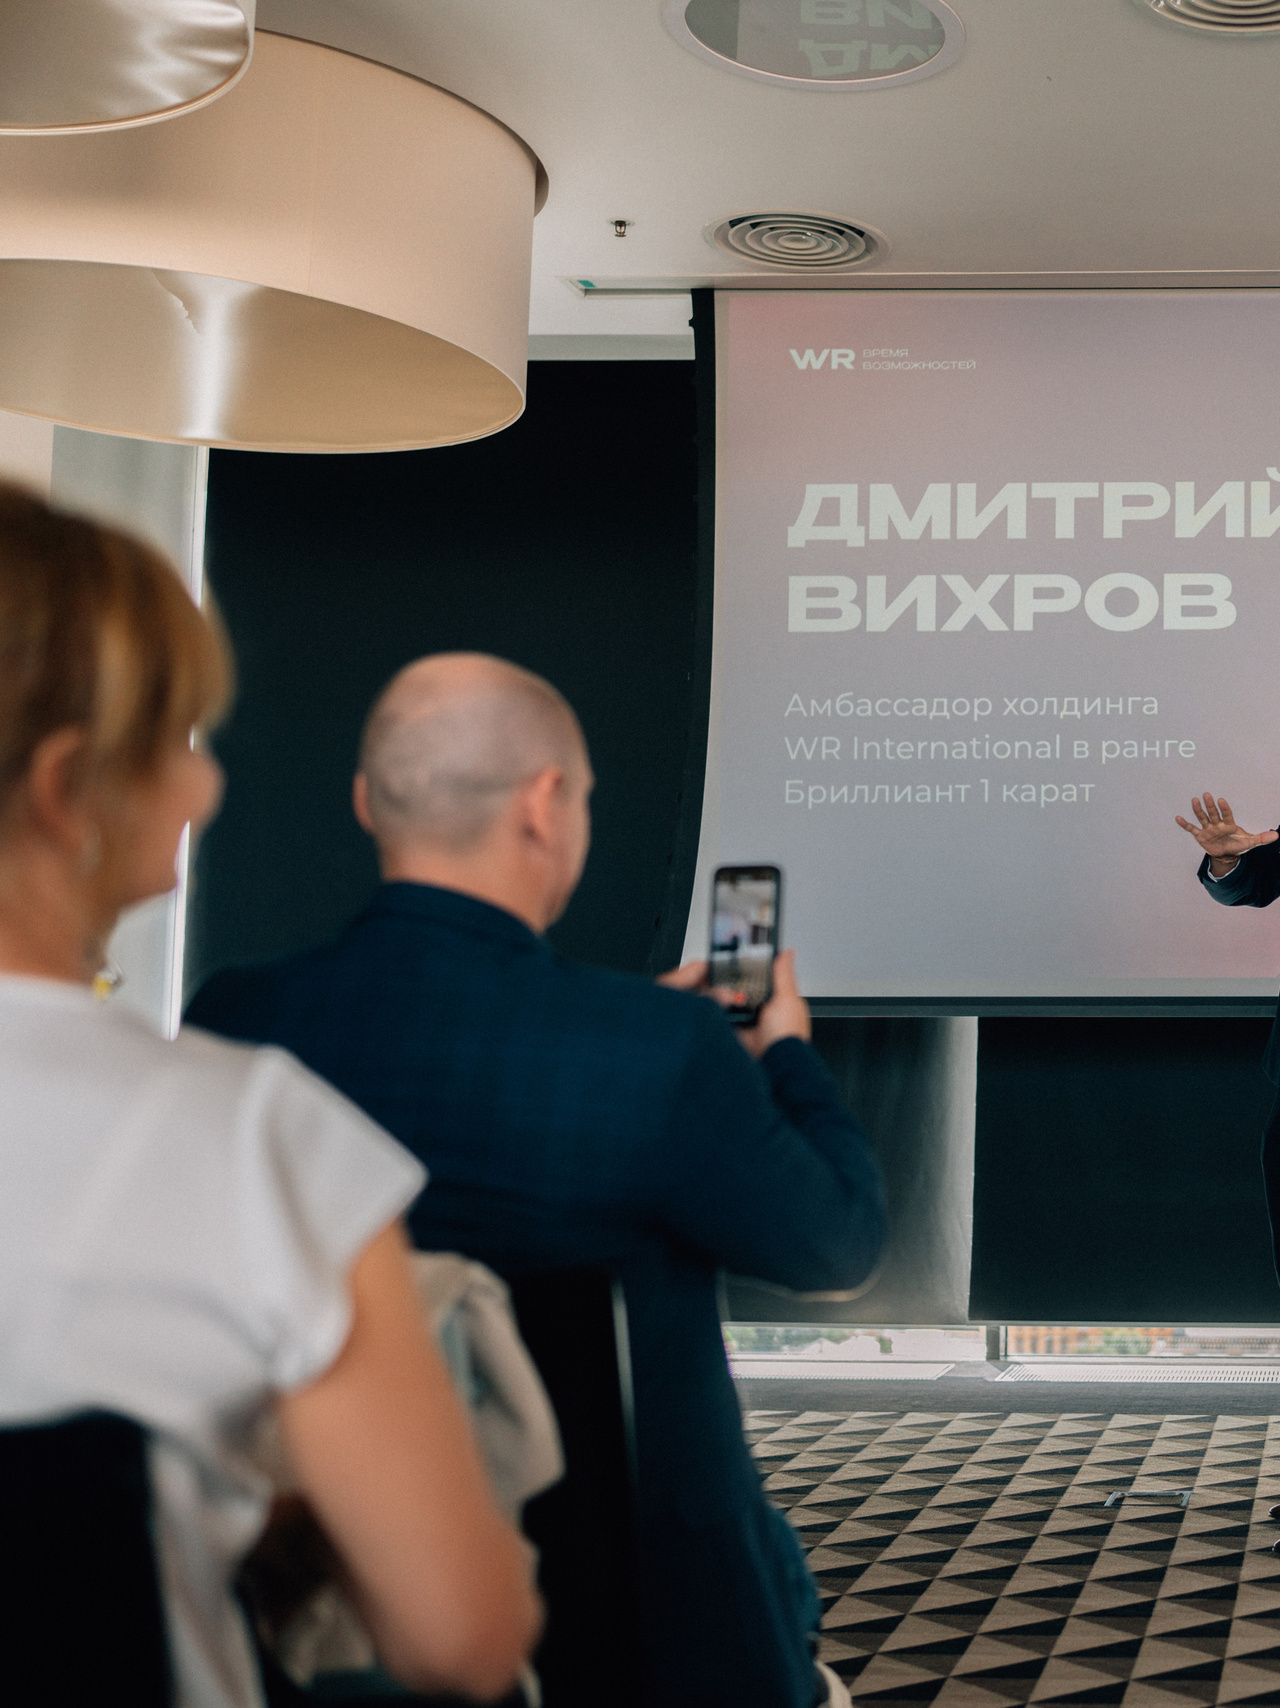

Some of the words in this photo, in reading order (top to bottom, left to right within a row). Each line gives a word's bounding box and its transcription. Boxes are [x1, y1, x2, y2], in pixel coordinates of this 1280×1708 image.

[789, 348, 856, 370] WR
[863, 348, 909, 357] ВРЕМЯ
[863, 360, 976, 370] ВОЗМОЖНОСТЕЙ
[787, 572, 1237, 632] ВИХРОВ
[784, 692, 993, 721] Амбассадор
[1002, 696, 1159, 718] холдинга
[784, 736, 841, 760] WR
[853, 734, 1061, 760] International
[1072, 742, 1089, 759] в
[1101, 738, 1197, 764] ранге
[784, 779, 971, 809] Бриллиант
[979, 779, 990, 801] 1
[1002, 782, 1095, 808] карат
